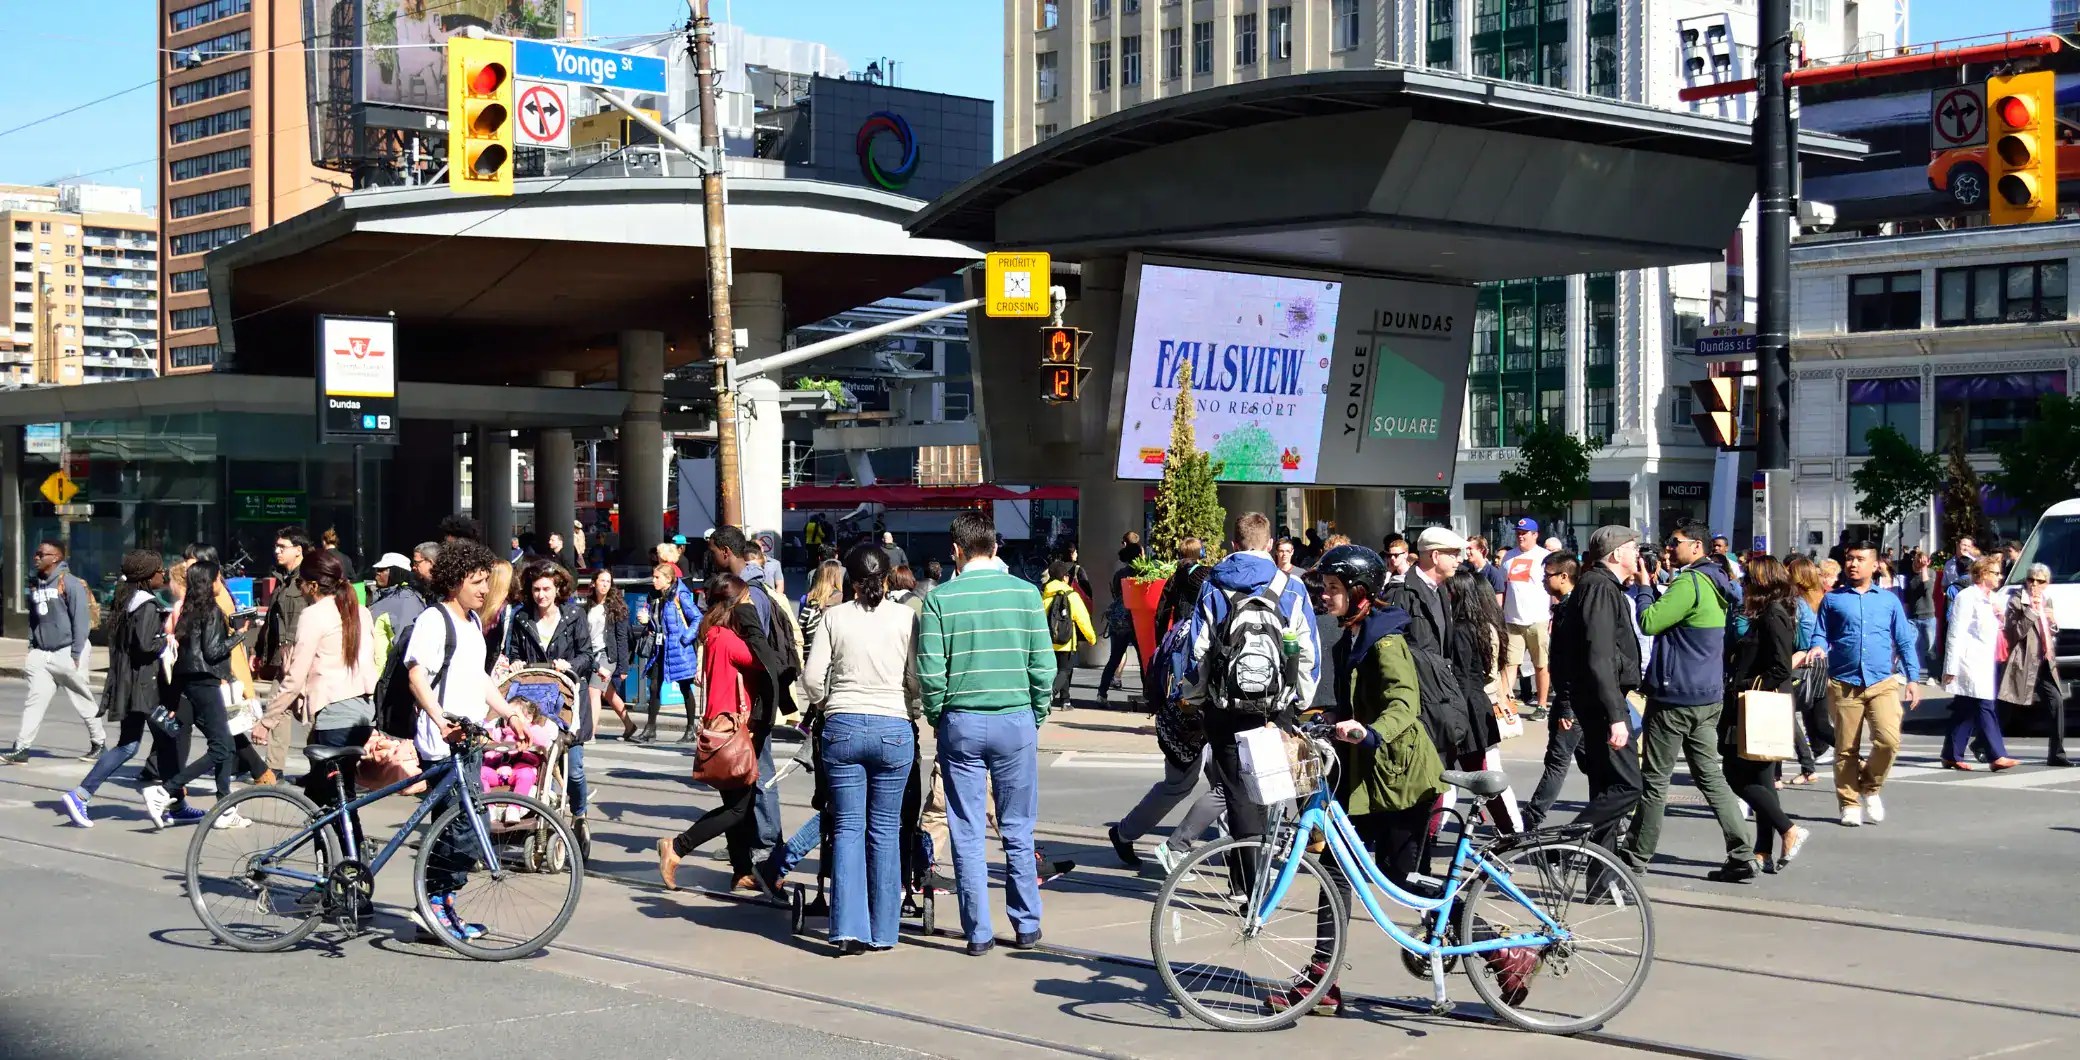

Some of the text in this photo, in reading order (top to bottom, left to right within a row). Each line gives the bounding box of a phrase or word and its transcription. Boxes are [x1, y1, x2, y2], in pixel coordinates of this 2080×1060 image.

[552, 46, 633, 83] Yonge St
[998, 257, 1036, 268] PRIORITY
[996, 301, 1039, 312] CROSSING
[1382, 311, 1453, 332] DUNDAS
[1700, 337, 1751, 353] Dundas St E
[1153, 339, 1305, 396] FALLSVIEW
[1053, 369, 1069, 396] 12
[1344, 346, 1367, 436] YONGE
[330, 399, 361, 409] Dundas
[1151, 396, 1297, 416] CANO RESORT
[1373, 416, 1438, 436] SQUARE
[1667, 485, 1704, 495] INGLOT
[398, 793, 439, 840] TREK
